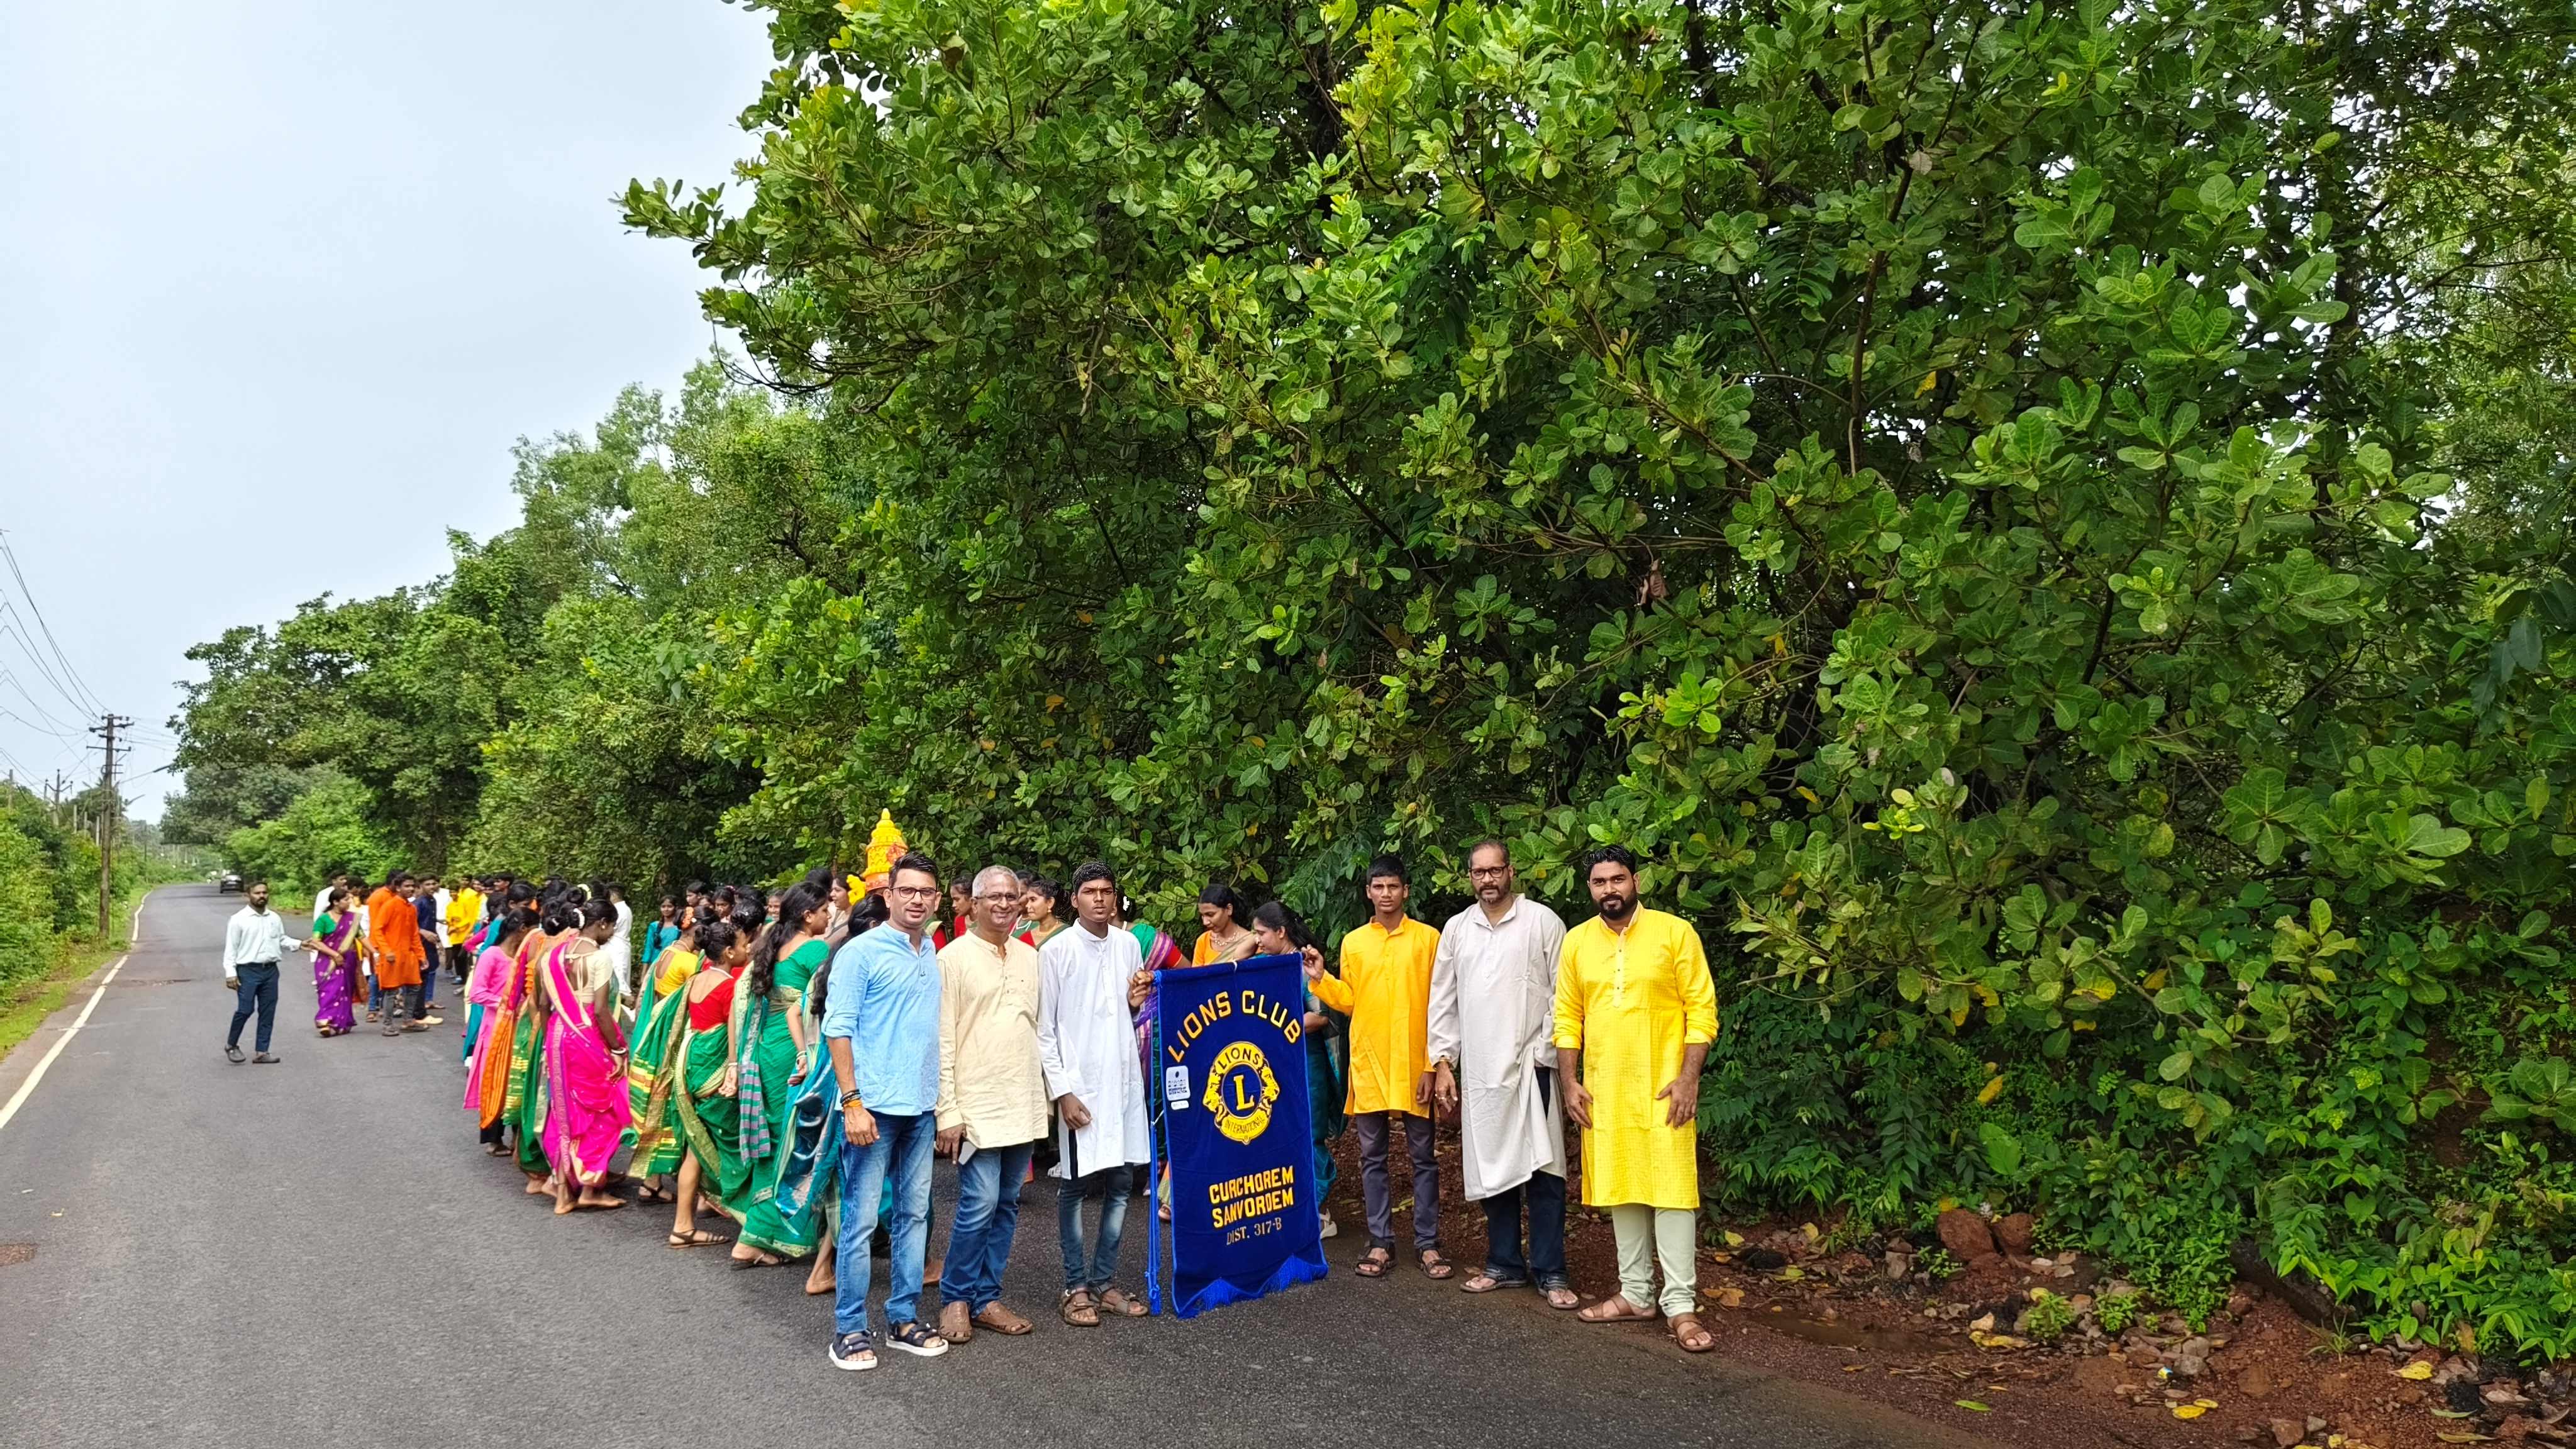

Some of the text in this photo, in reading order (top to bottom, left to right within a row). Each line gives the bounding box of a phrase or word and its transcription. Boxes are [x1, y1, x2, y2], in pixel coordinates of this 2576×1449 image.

[1167, 989, 1302, 1063] LIONS CLUB
[1218, 1046, 1261, 1070] LIONS
[1233, 1074, 1255, 1111] L
[1209, 1165, 1294, 1204] CURCHOREM
[1211, 1187, 1294, 1228] SANVORDEM
[1226, 1217, 1282, 1245] DIST. 317-B
